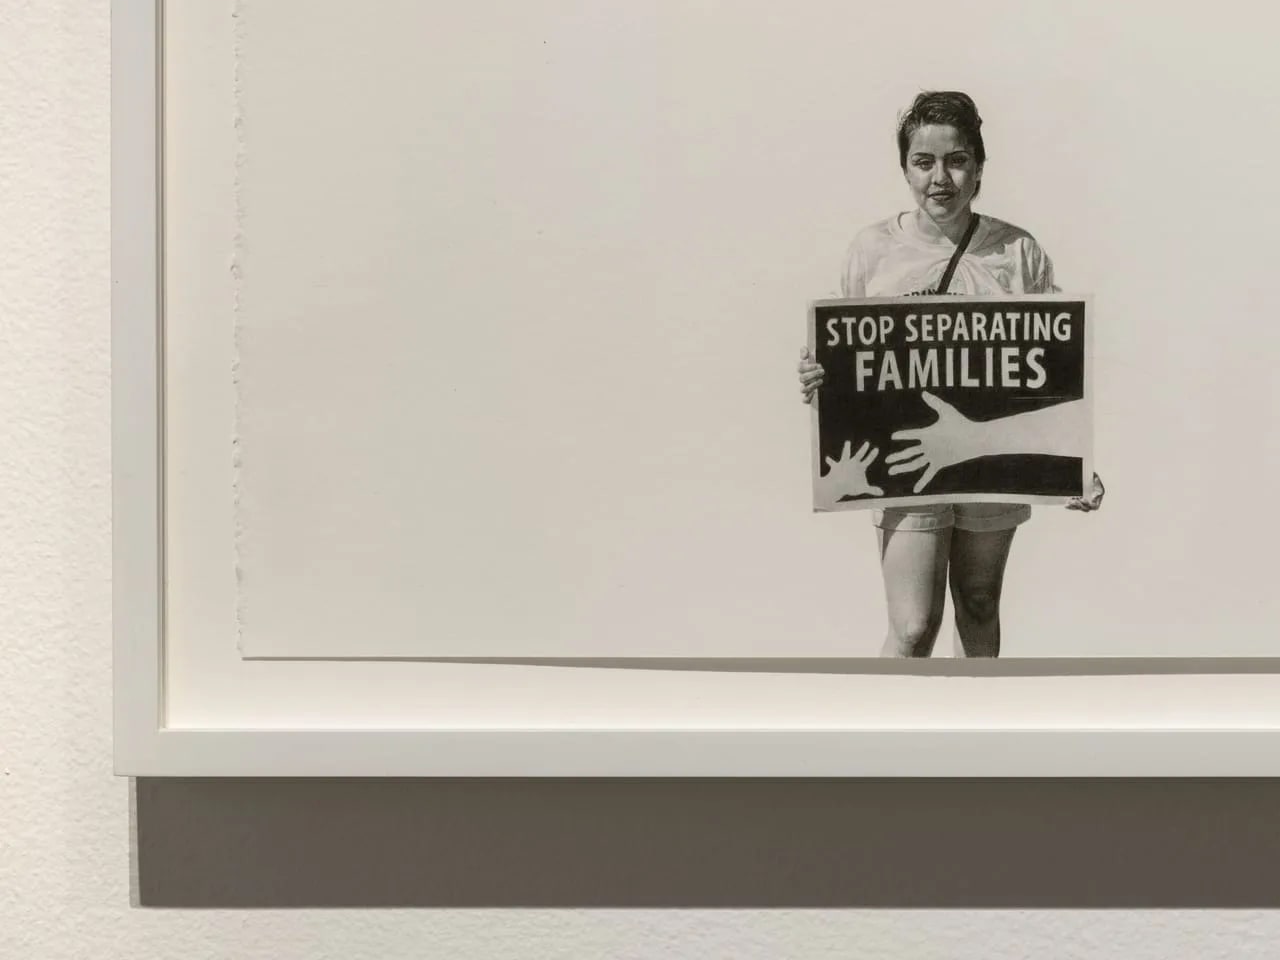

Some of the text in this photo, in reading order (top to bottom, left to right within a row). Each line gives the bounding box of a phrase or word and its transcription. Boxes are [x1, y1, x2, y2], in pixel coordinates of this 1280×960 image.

[826, 312, 1072, 347] STOP SEPARATING
[855, 346, 1047, 392] FAMILIES
